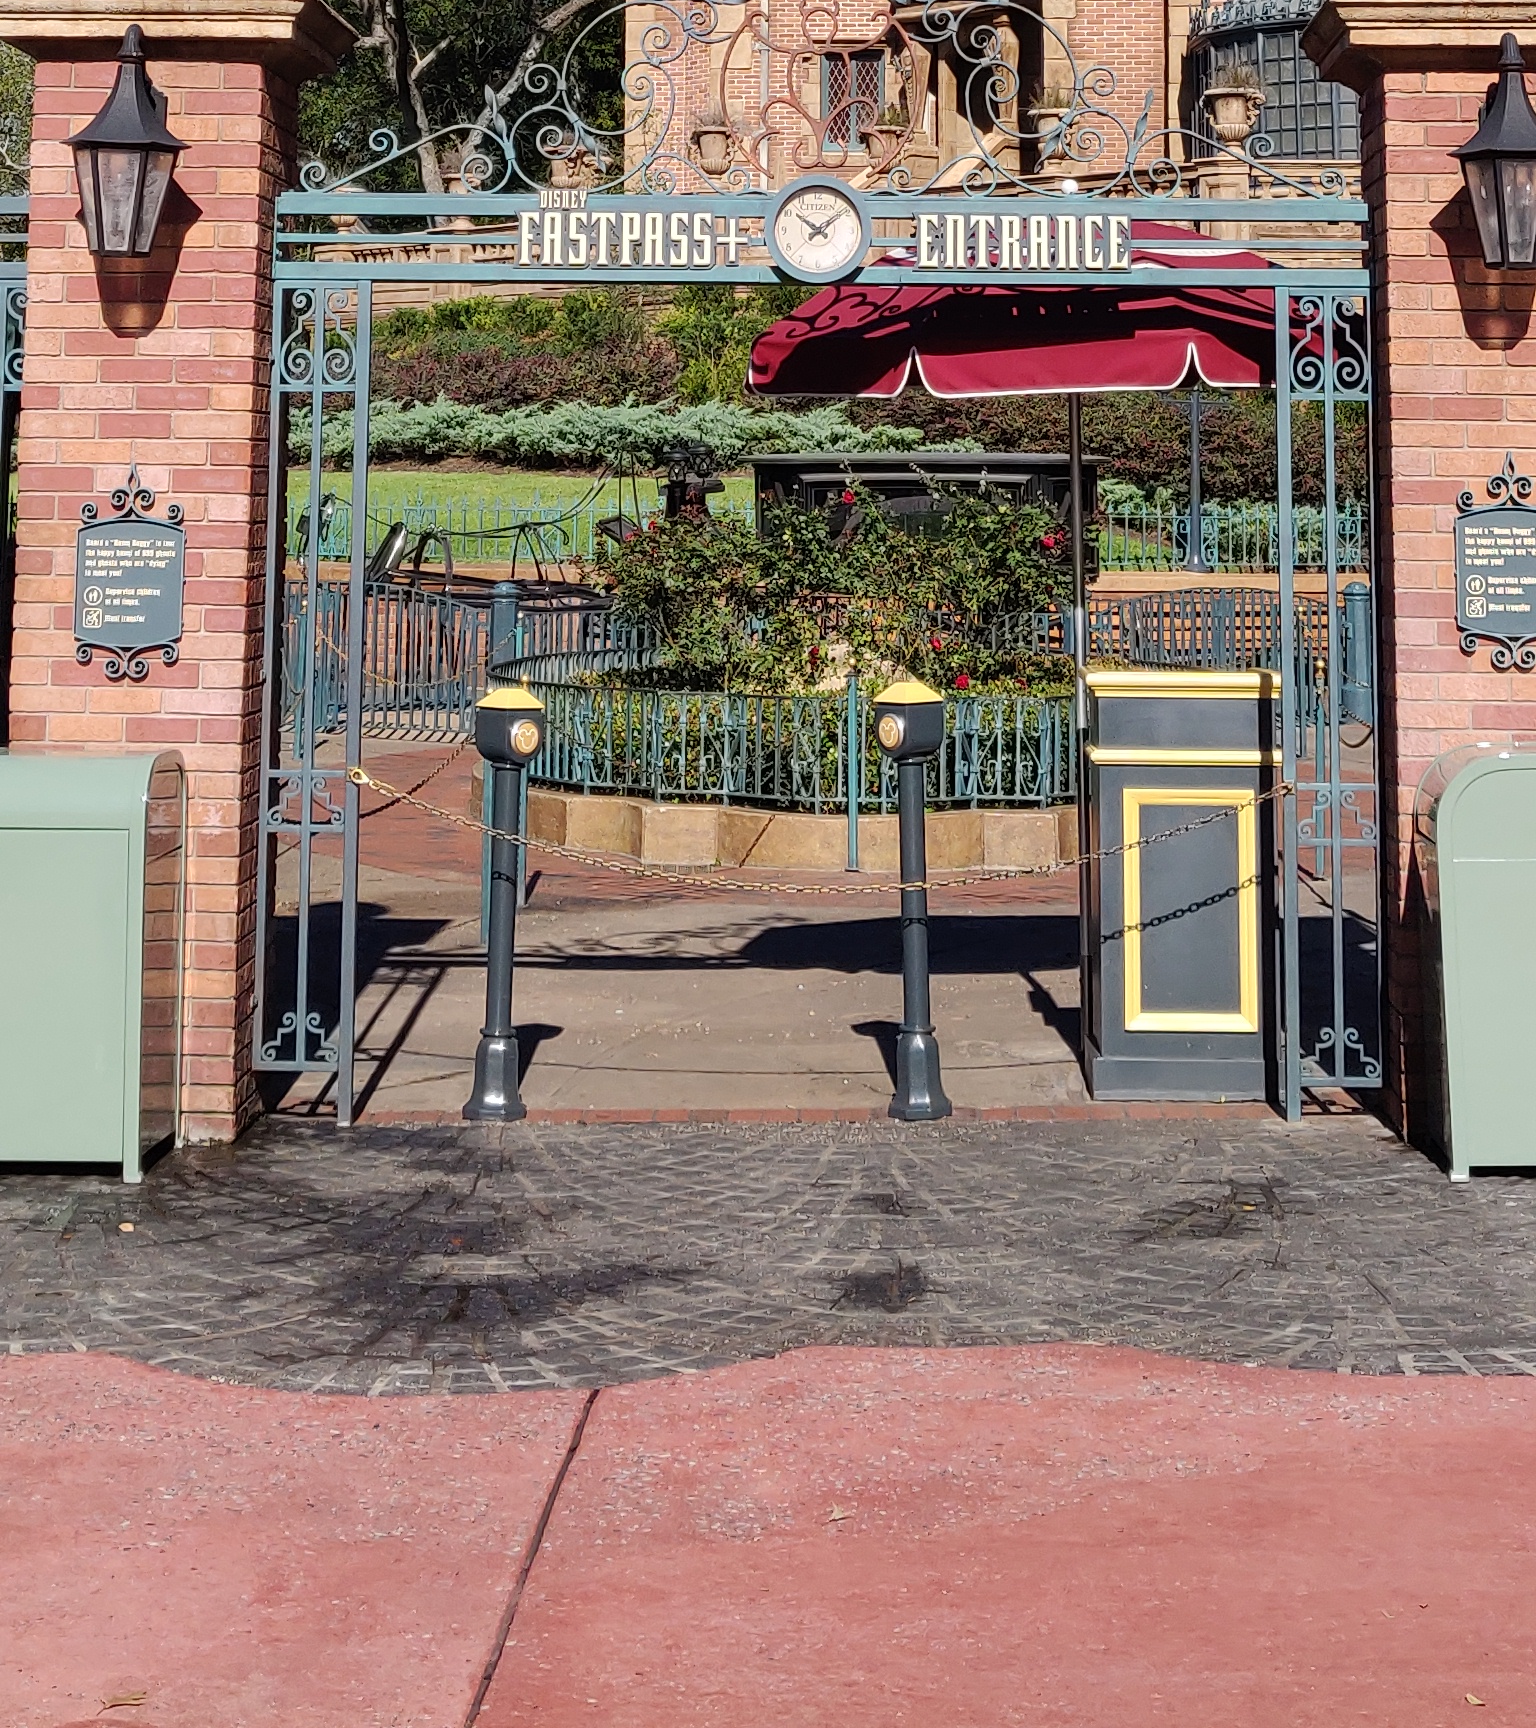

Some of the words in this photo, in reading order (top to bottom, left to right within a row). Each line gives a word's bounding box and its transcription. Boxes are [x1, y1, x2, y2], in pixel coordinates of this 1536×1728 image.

[539, 190, 587, 209] DISNEY
[784, 209, 792, 217] 10
[799, 203, 835, 211] CITIZEN
[917, 214, 1130, 270] ENTRANCE
